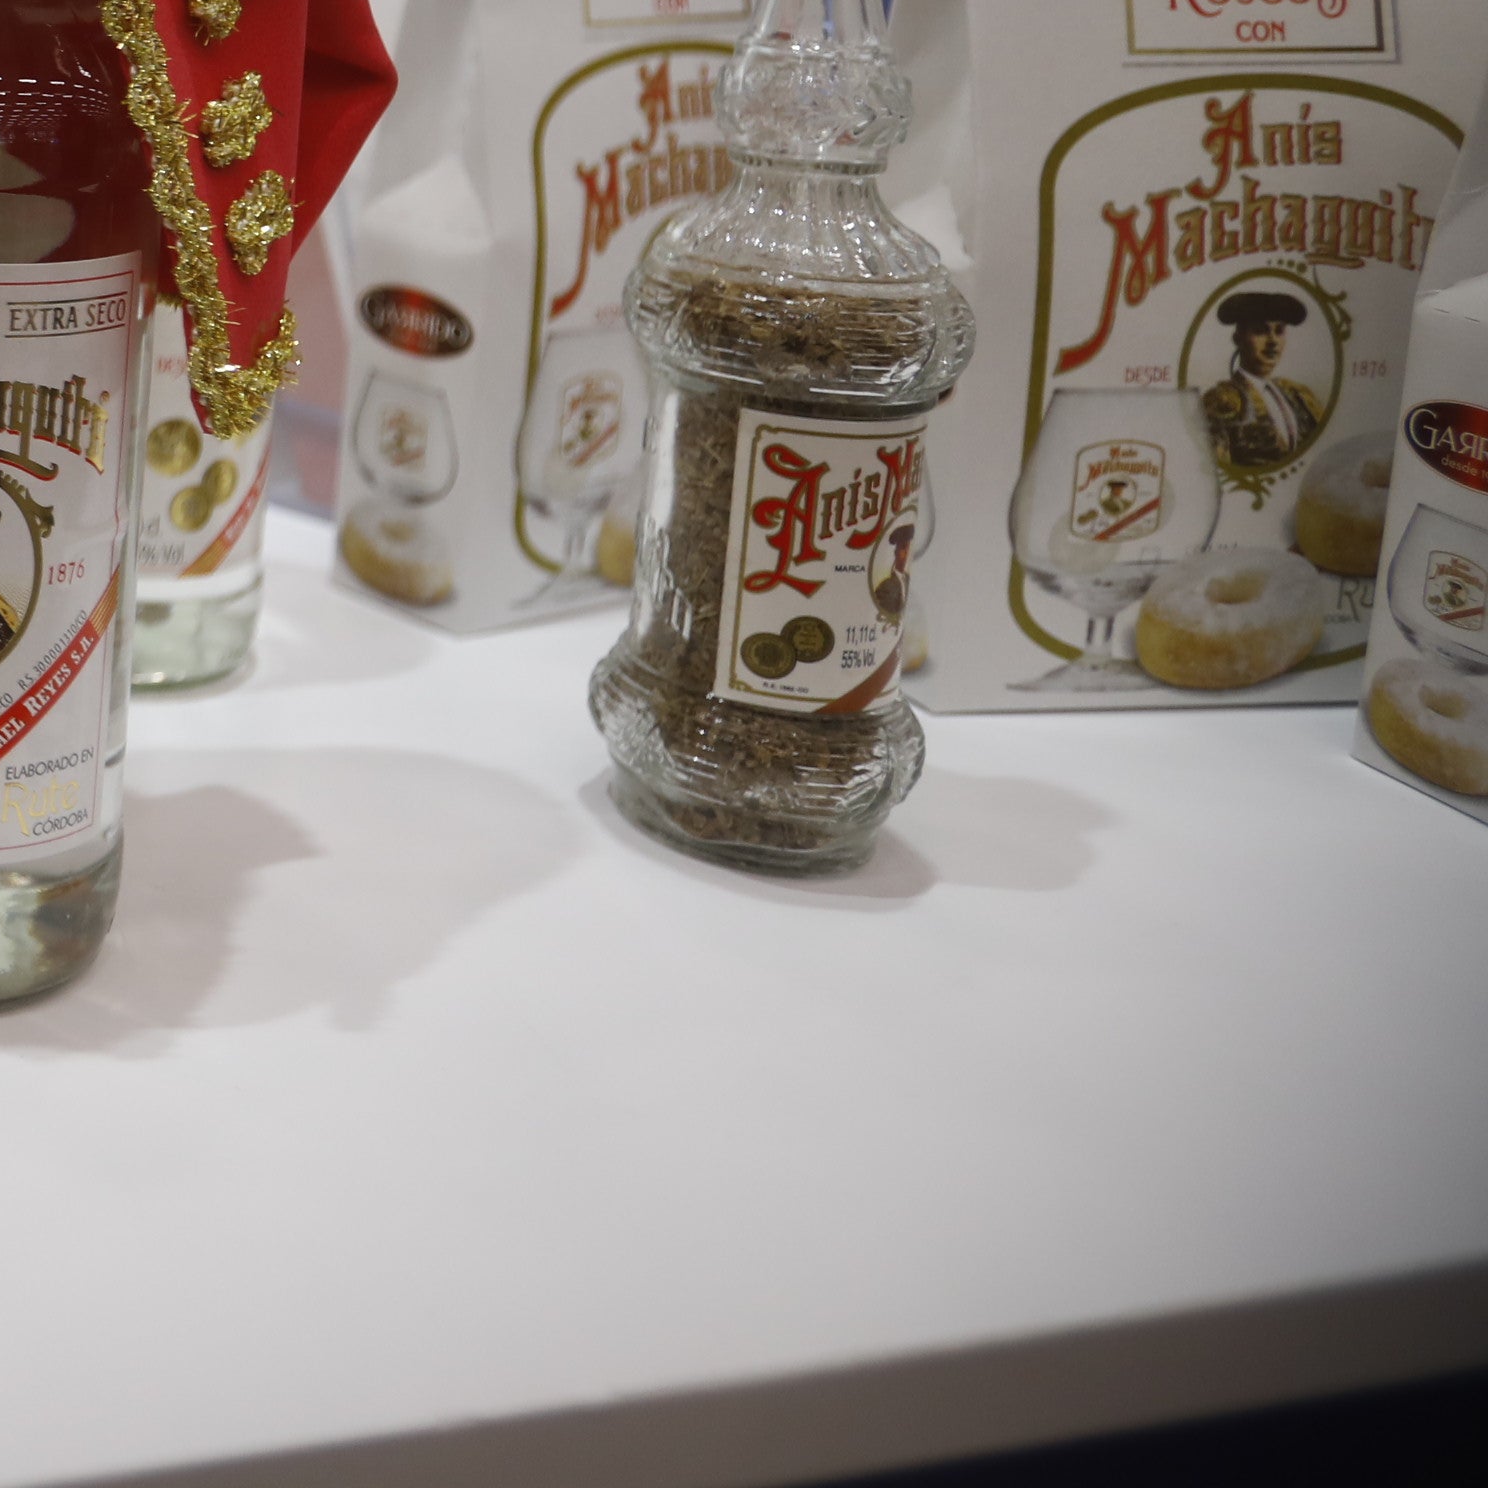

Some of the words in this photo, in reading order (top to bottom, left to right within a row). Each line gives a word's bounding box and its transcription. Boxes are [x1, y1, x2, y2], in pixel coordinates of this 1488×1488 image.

[1054, 175, 1435, 377] Machaquit
[10, 306, 77, 332] EXTRA
[86, 298, 125, 327] SECO
[1125, 365, 1171, 386] DESDE
[1351, 360, 1387, 380] 1876
[48, 560, 85, 587] 1876
[834, 563, 866, 573] MARCA
[23, 663, 72, 717] REYES
[5, 752, 79, 780] ELABORADO
[81, 746, 94, 763] EN
[2, 776, 80, 837] Rute
[32, 809, 88, 836] CÓRDOBA
